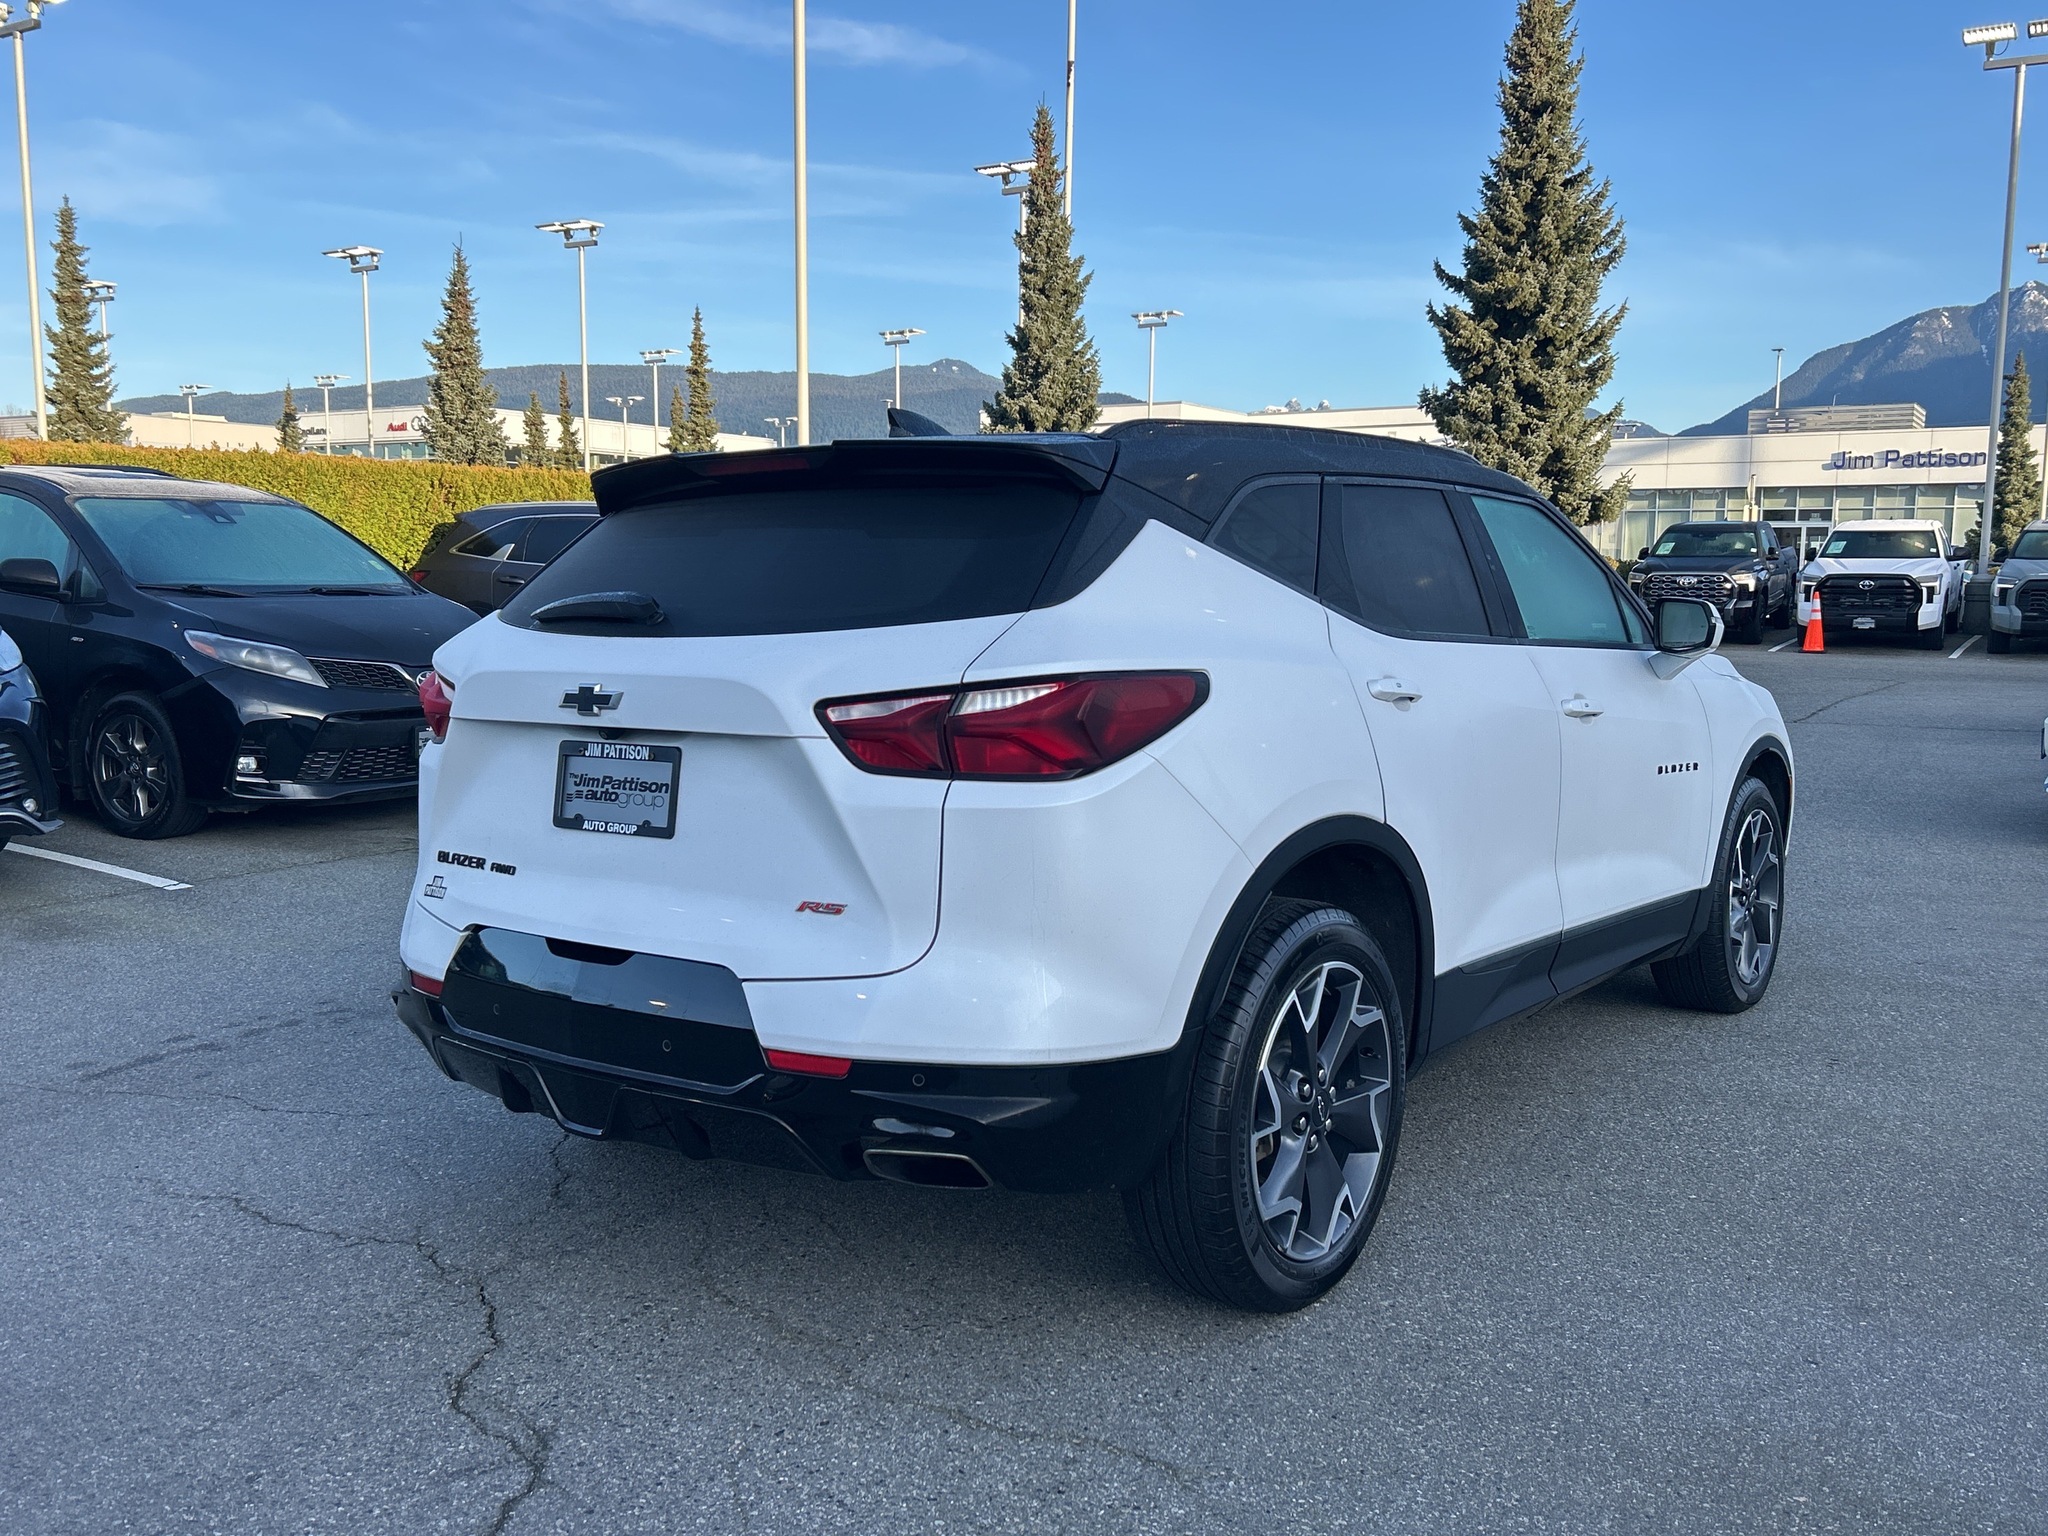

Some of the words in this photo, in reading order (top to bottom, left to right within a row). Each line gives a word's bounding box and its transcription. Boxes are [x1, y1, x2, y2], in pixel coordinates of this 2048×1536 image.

[386, 422, 407, 432] Audi
[1833, 450, 1874, 470] Jim
[1885, 448, 1987, 468] Pattison
[585, 743, 602, 757] JIM
[603, 744, 650, 760] PATTISON
[1657, 762, 1699, 775] BLAZER
[569, 772, 580, 780] The
[582, 820, 606, 832] AUTO
[606, 822, 638, 835] GROUP
[437, 850, 486, 870] BLAZER
[490, 862, 517, 876] AWD
[795, 901, 848, 915] RS
